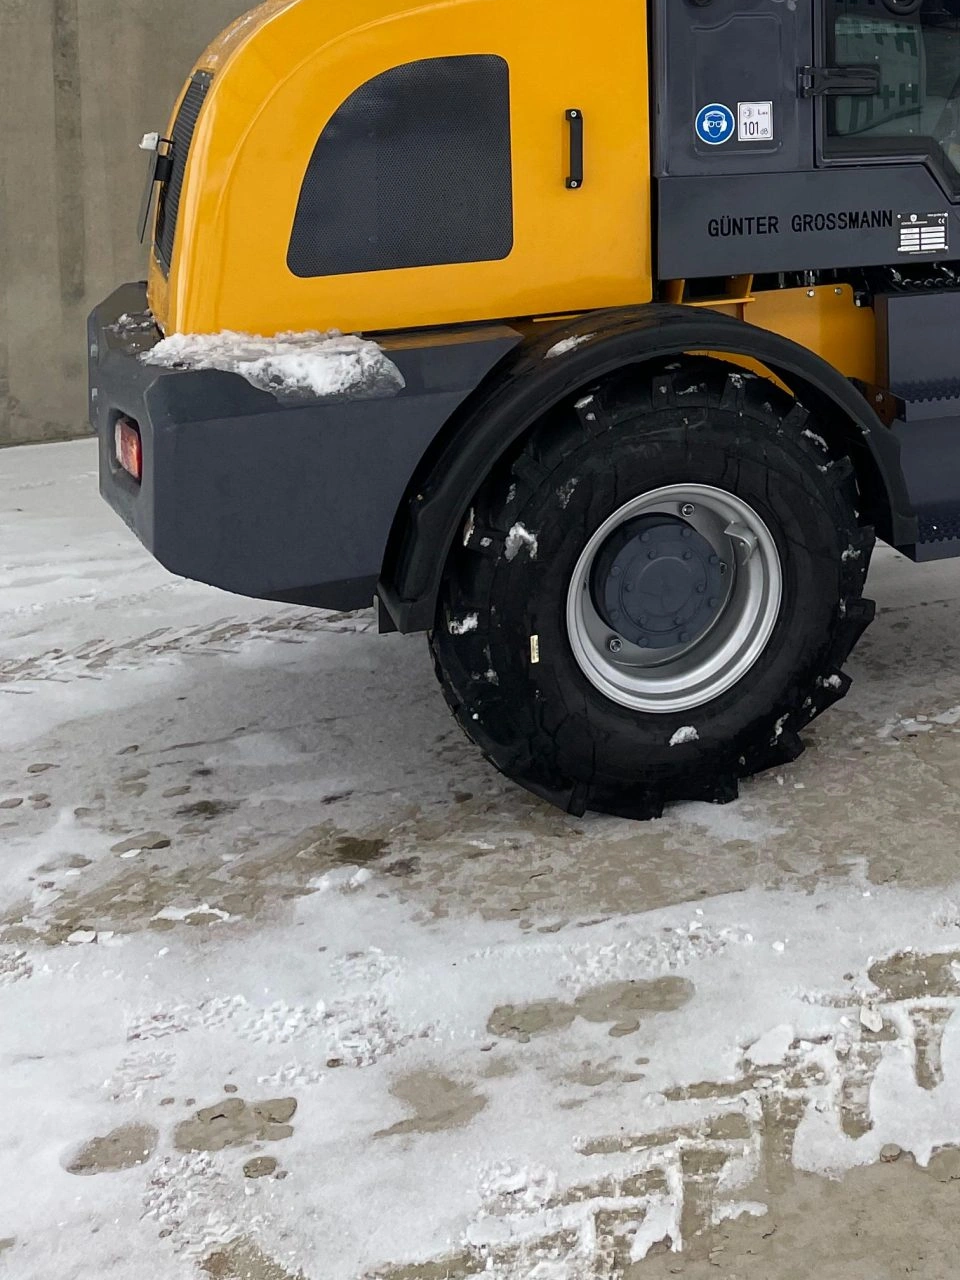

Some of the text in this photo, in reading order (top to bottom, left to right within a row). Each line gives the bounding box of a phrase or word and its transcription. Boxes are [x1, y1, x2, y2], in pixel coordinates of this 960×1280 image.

[743, 121, 759, 136] 101
[707, 209, 893, 238] GÜNTER GROSSMANN
